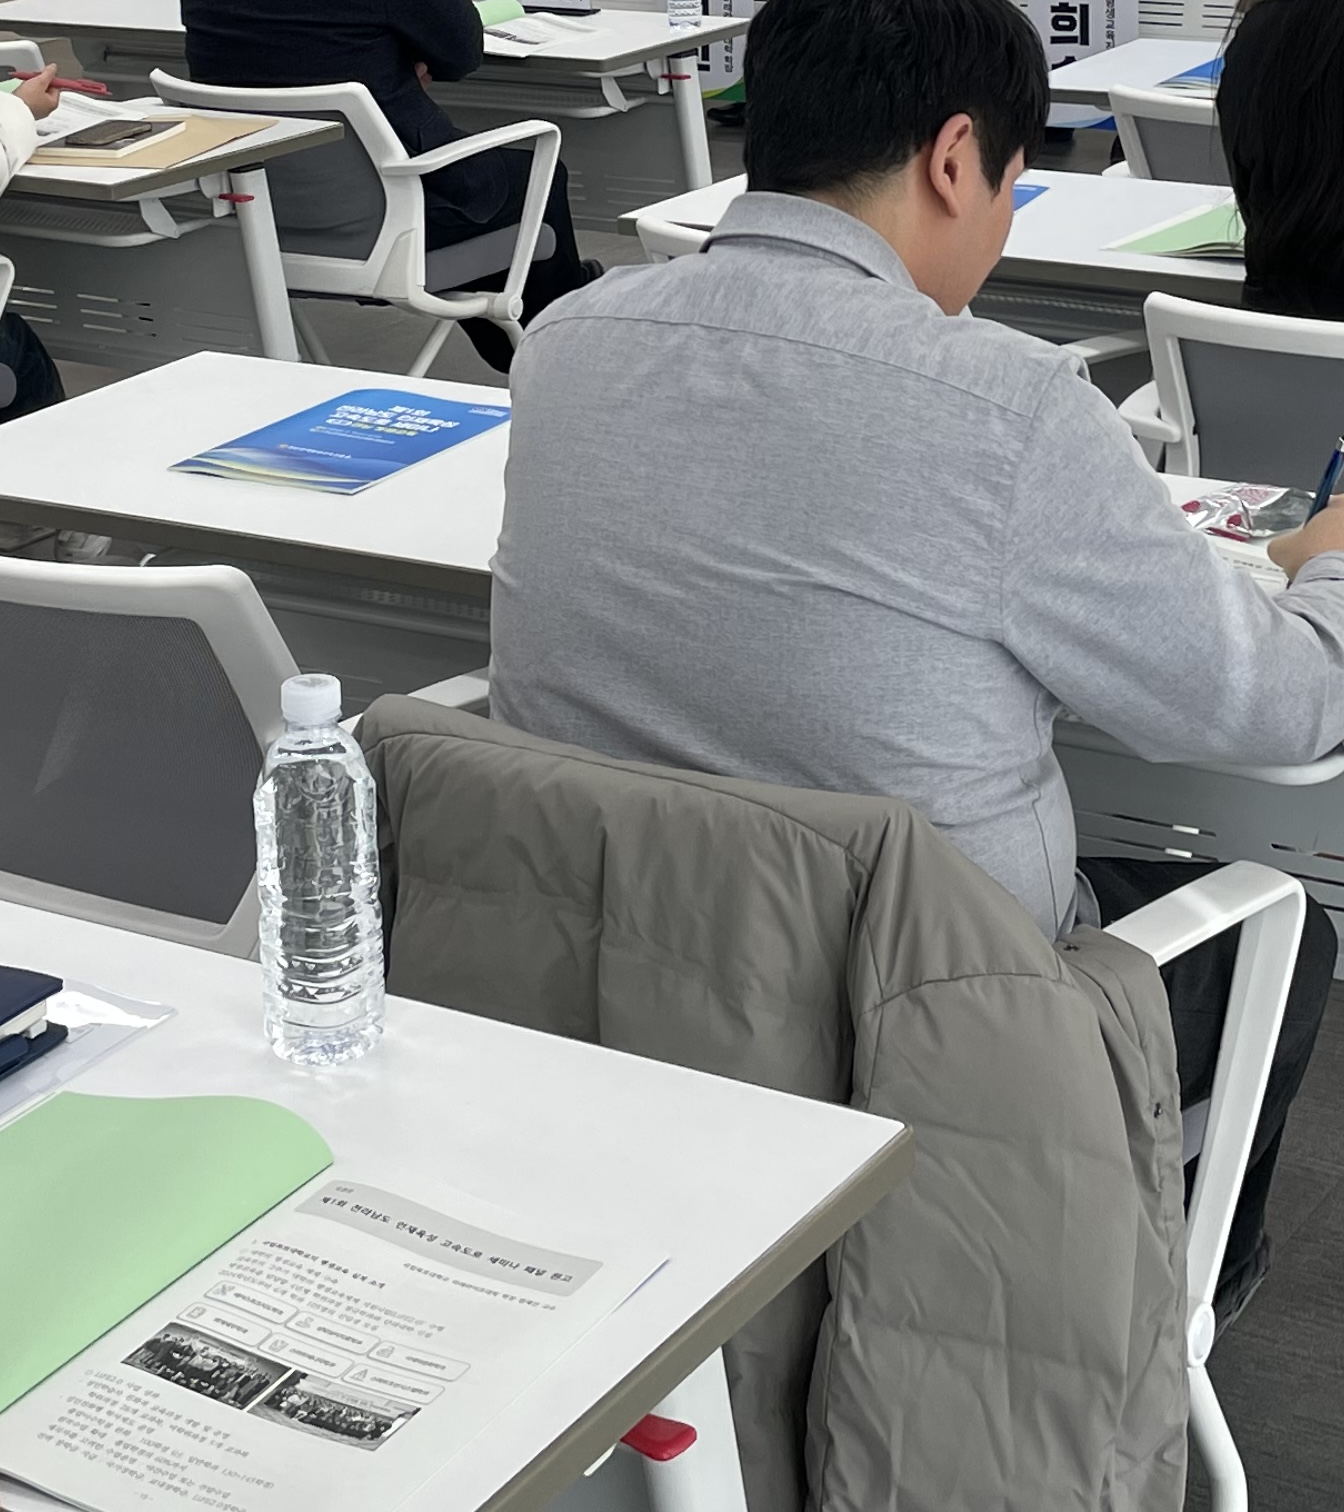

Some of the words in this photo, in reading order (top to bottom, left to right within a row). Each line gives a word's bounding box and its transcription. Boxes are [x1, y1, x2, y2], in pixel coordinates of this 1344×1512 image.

[351, 1205, 390, 1223] 전라남도
[396, 1222, 438, 1242] 인재육성
[440, 1240, 483, 1258] 고속도로
[488, 1256, 520, 1269] 세미나
